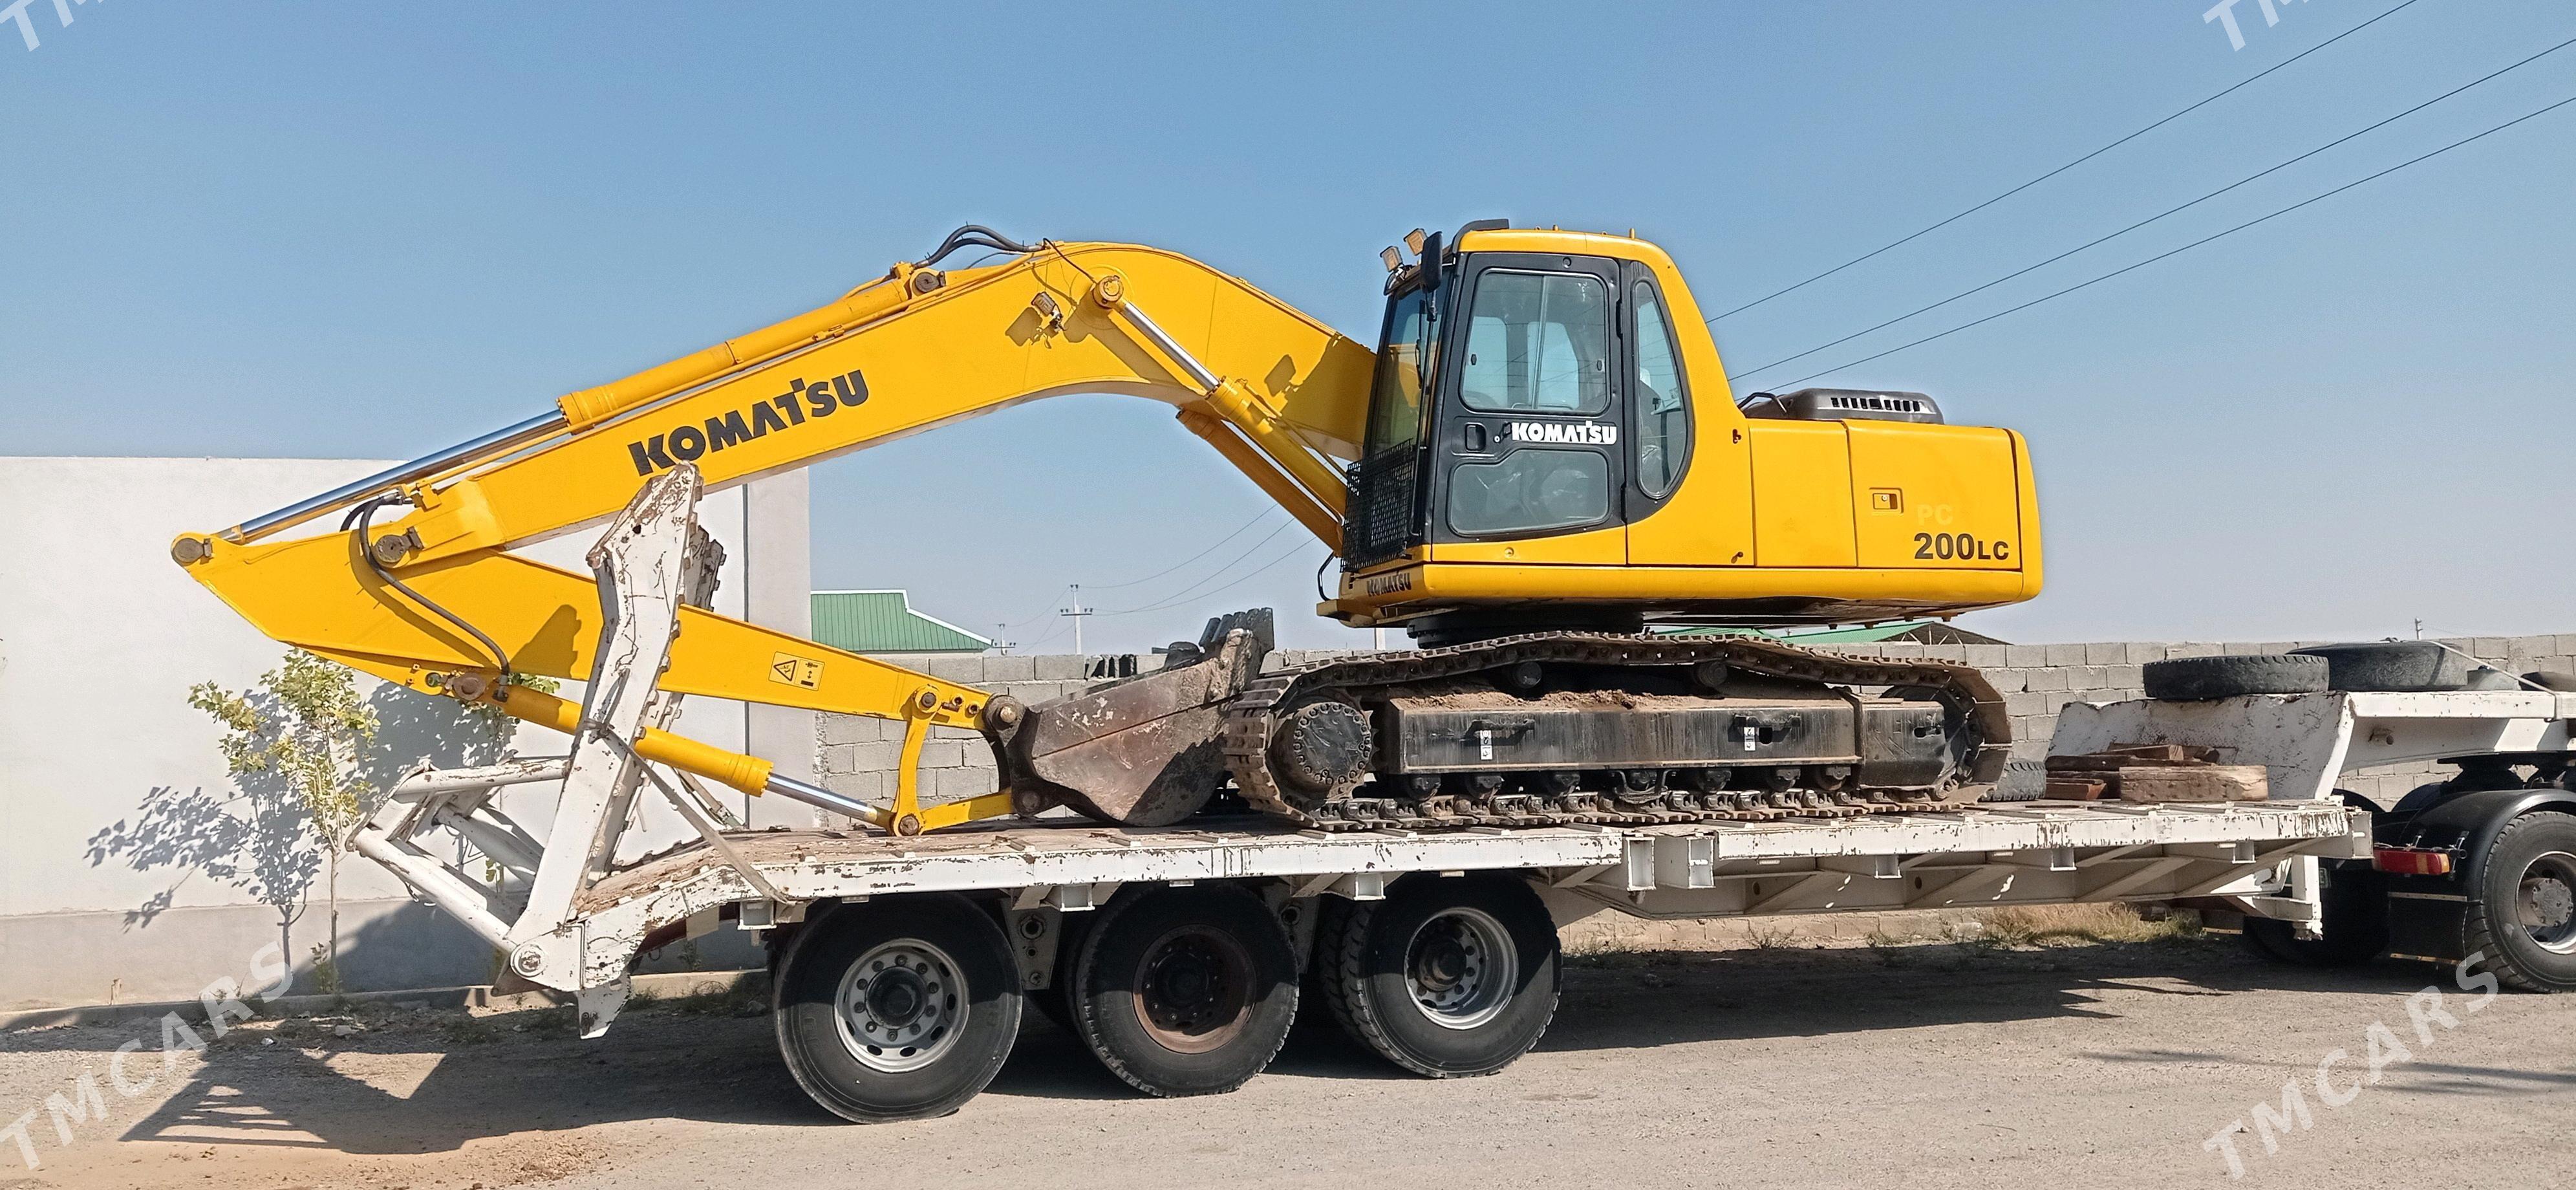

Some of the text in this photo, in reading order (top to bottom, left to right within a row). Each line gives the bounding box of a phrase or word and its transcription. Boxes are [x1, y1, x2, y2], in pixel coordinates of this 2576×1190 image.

[627, 369, 869, 477] KOMATSU
[1512, 420, 1617, 445] KOMATSU
[1917, 504, 1953, 526] PC
[1367, 570, 1412, 597] KOMATSU
